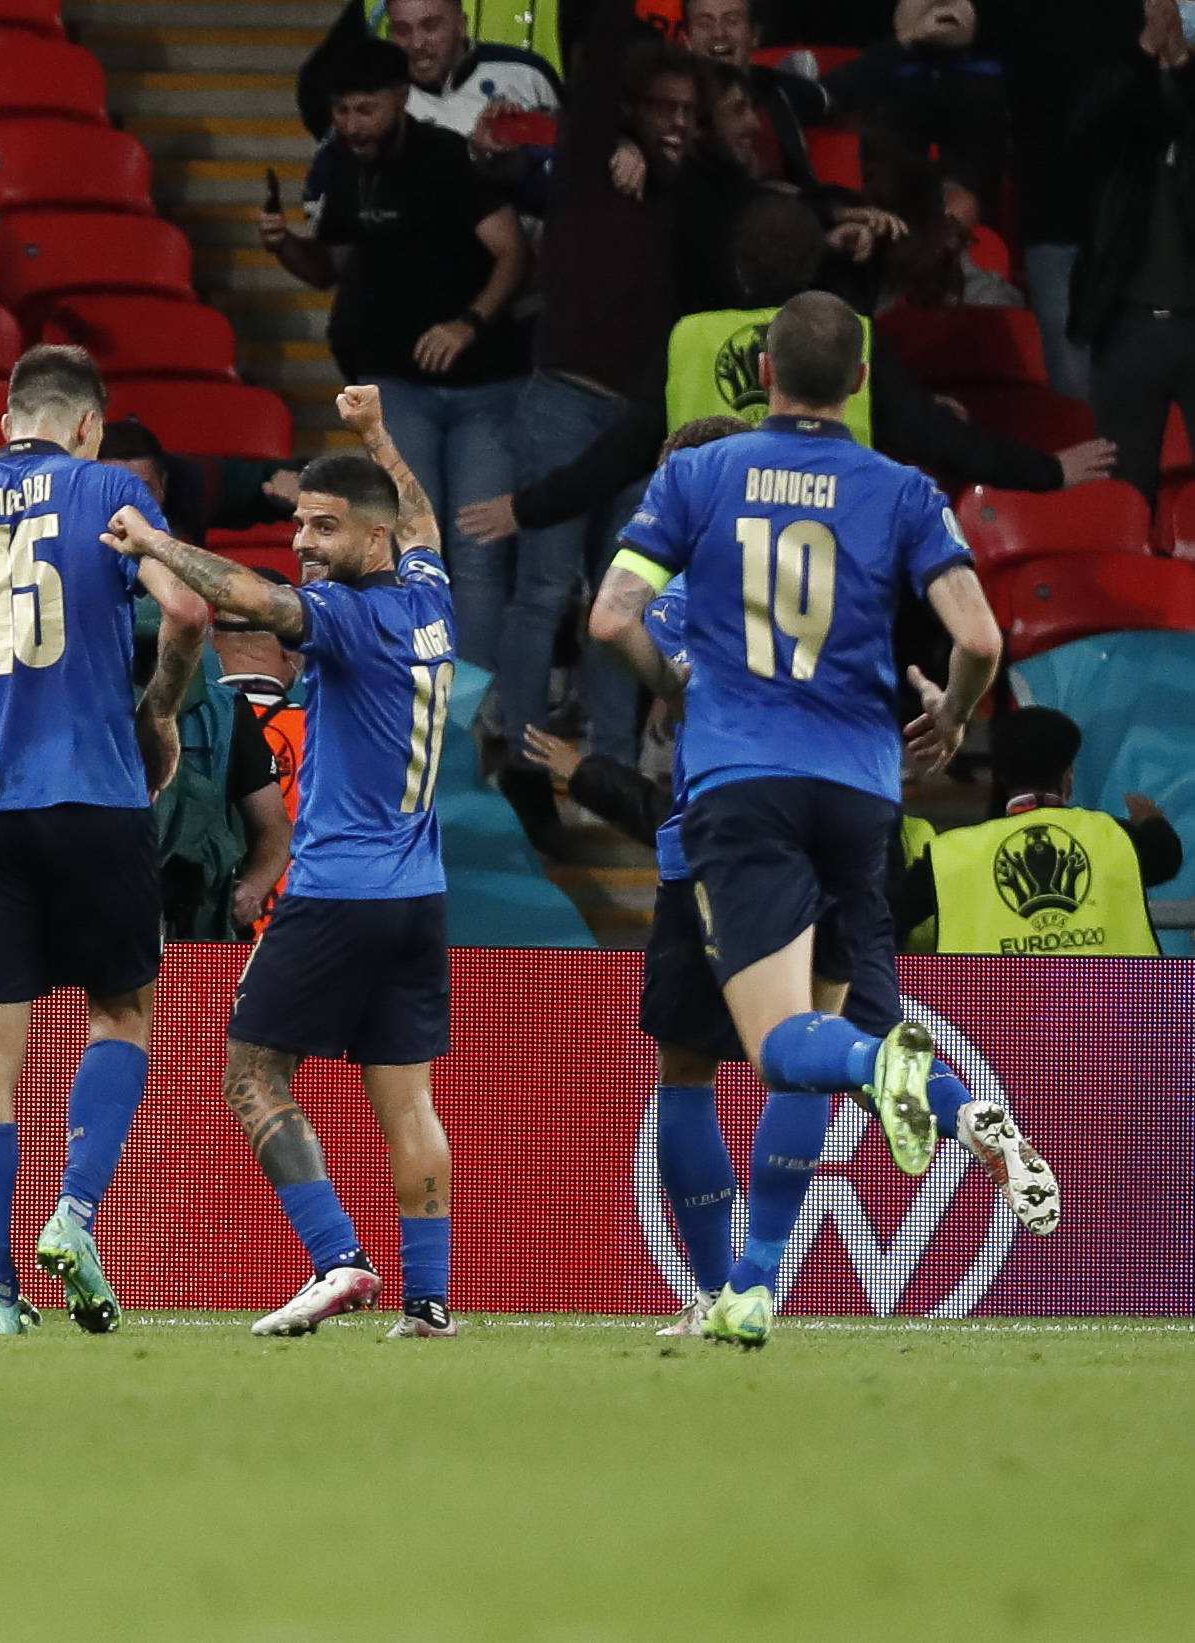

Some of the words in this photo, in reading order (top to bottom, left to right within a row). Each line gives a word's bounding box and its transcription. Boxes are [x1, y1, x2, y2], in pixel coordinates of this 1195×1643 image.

[746, 467, 838, 509] BONUCCI
[735, 517, 837, 682] 19
[999, 927, 1105, 955] EURO2020
